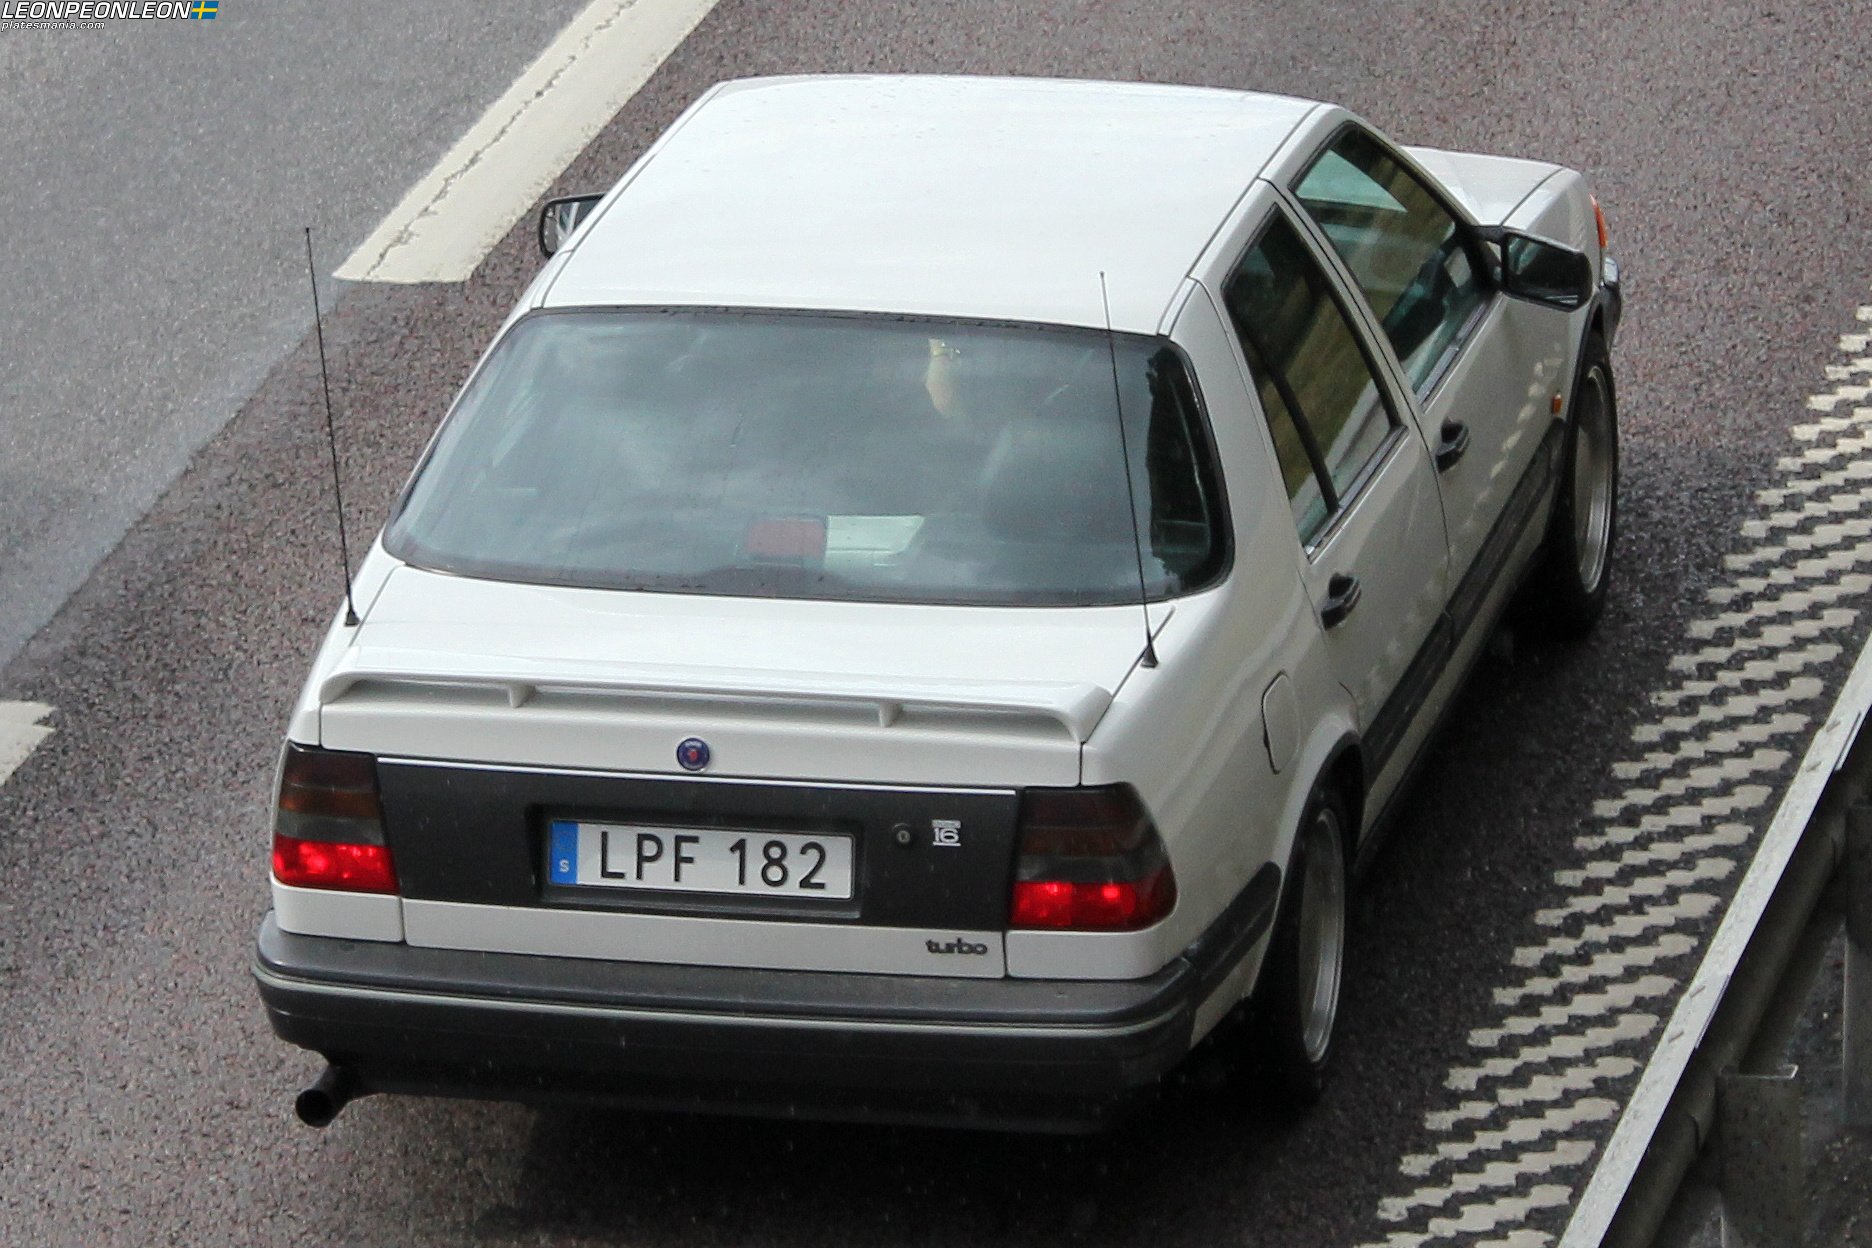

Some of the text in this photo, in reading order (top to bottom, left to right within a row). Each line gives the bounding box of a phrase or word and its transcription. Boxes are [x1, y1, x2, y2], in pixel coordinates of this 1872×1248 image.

[932, 827, 960, 843] 16
[558, 859, 570, 873] S
[600, 831, 827, 889] LPF 182
[925, 937, 988, 955] turbo
